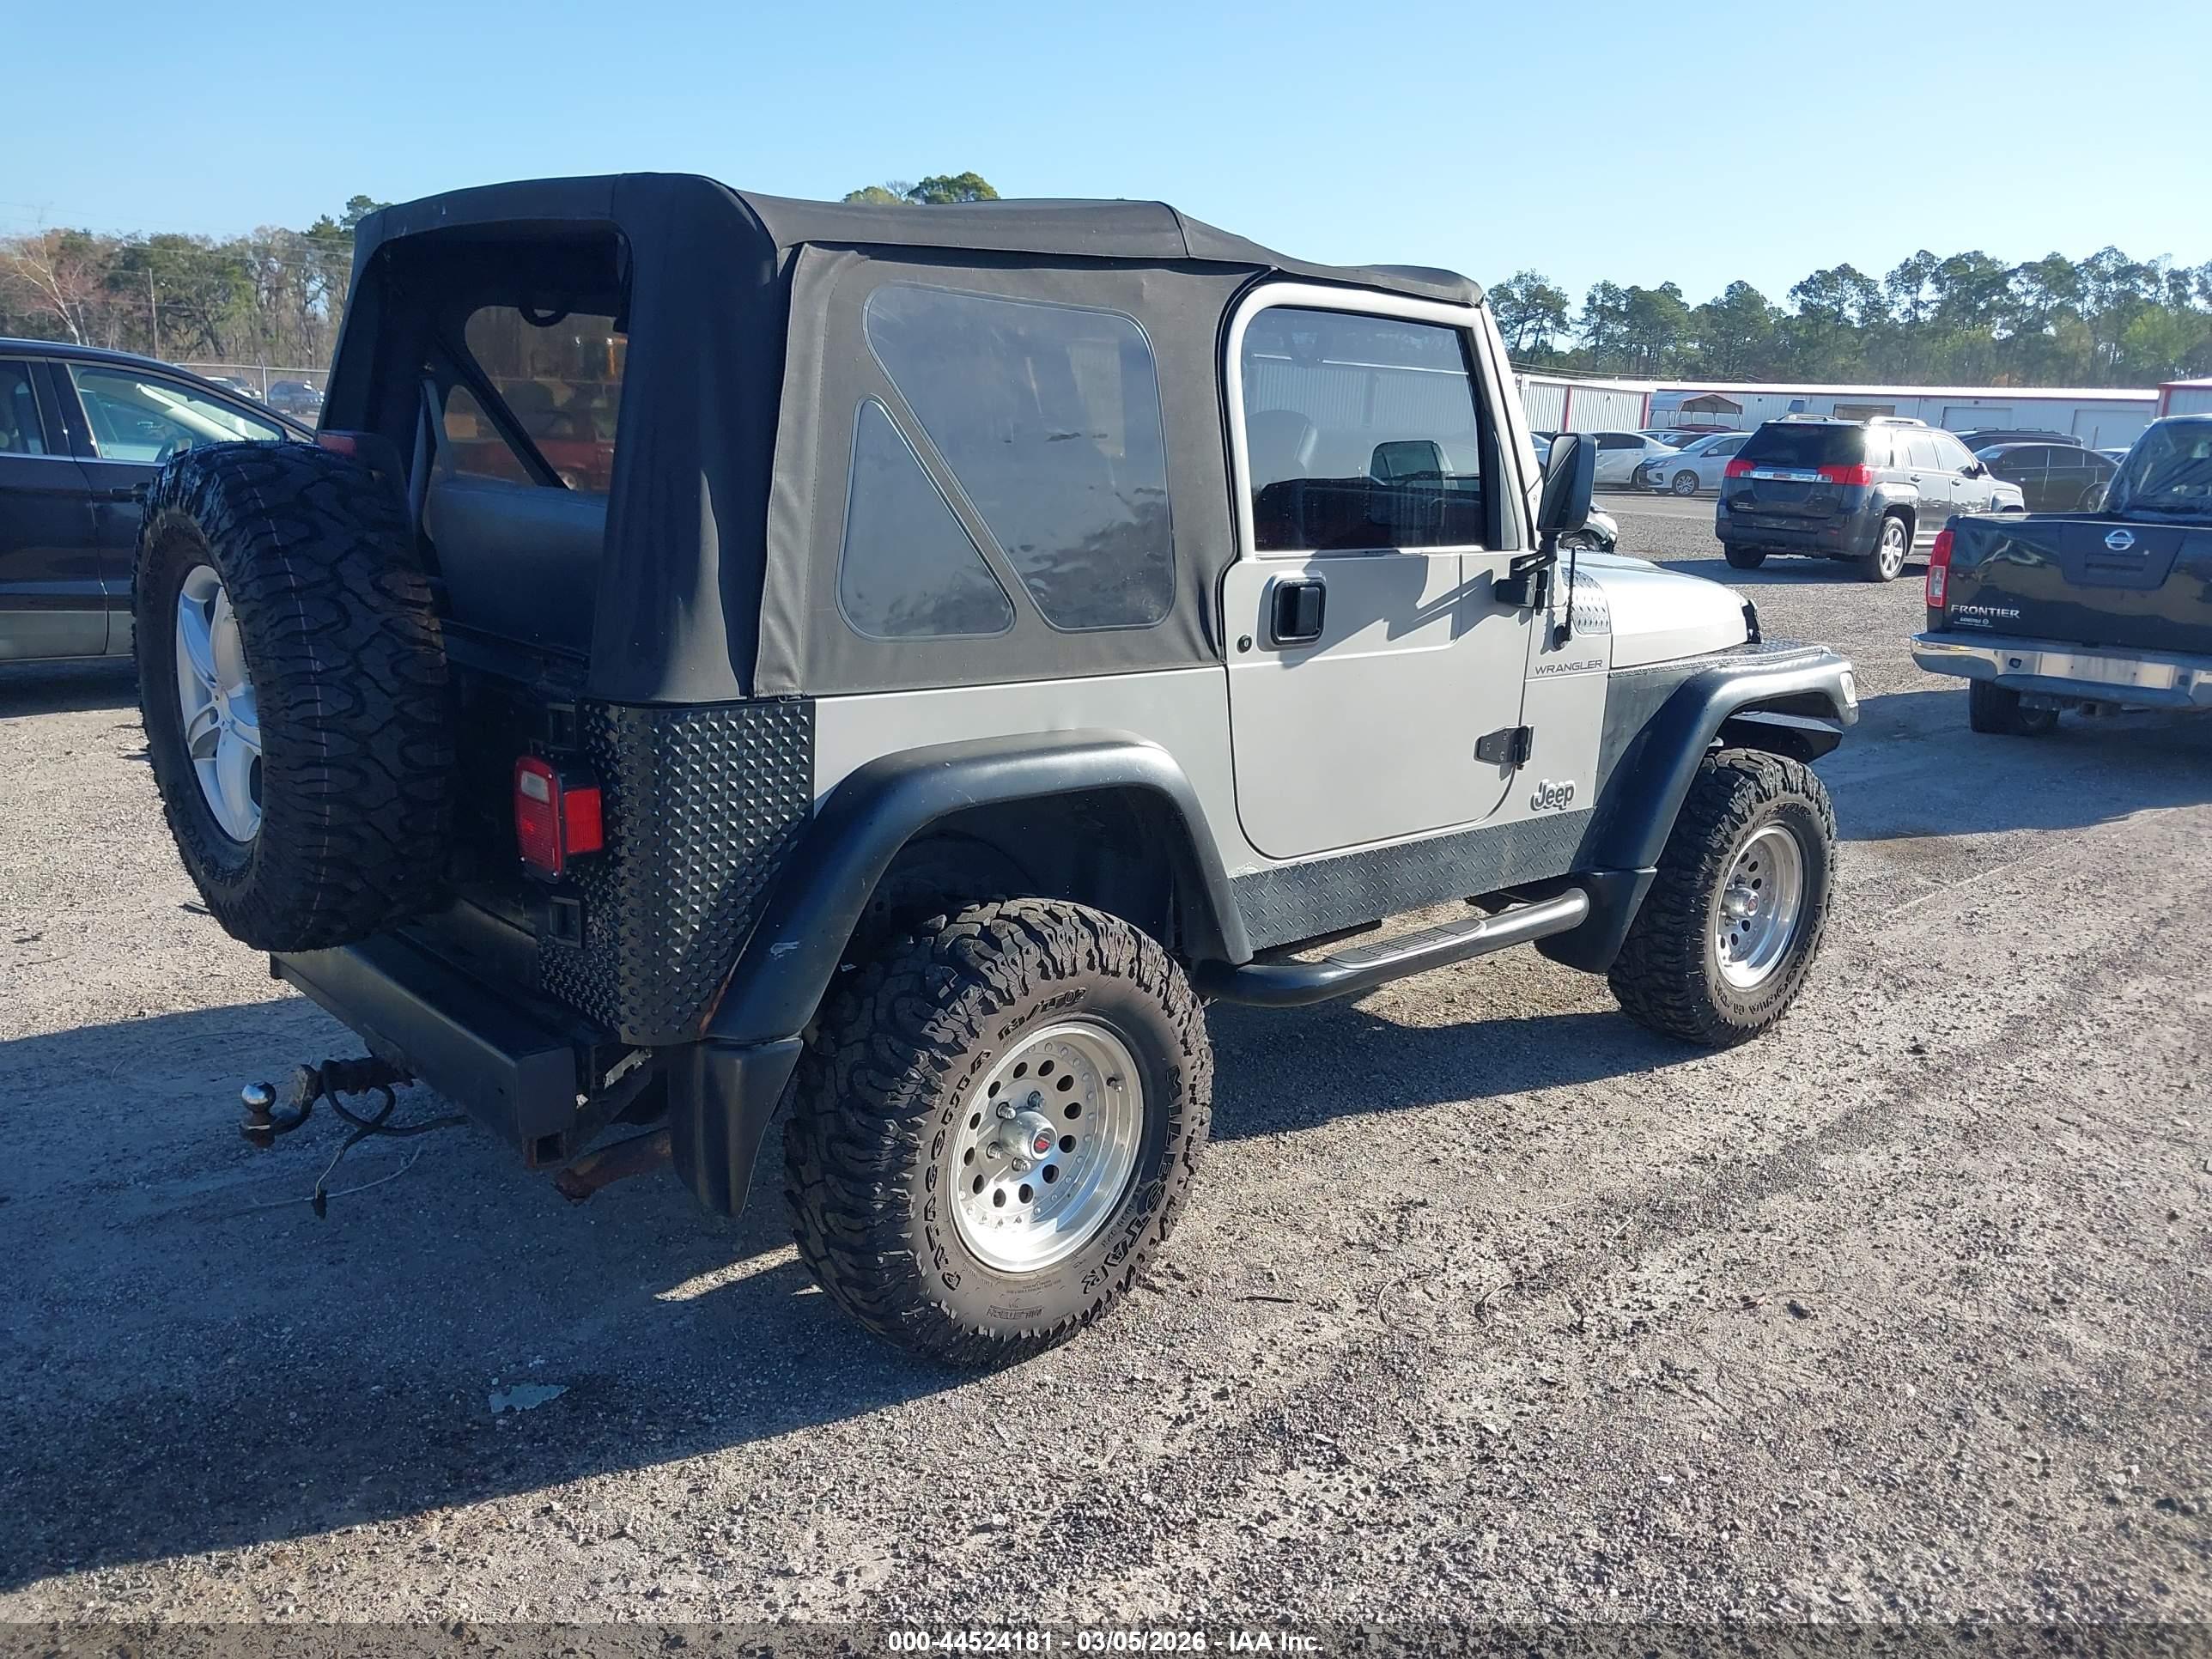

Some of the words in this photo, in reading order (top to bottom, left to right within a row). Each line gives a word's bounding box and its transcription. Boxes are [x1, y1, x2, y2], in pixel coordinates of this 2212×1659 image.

[1950, 604, 2021, 619] FRONTIER
[1534, 659, 1603, 675] WRANGLER
[1531, 779, 1576, 810] Jeep
[925, 1049, 994, 1291] PATAGONIA
[1081, 1063, 1184, 1295] MILESTAR
